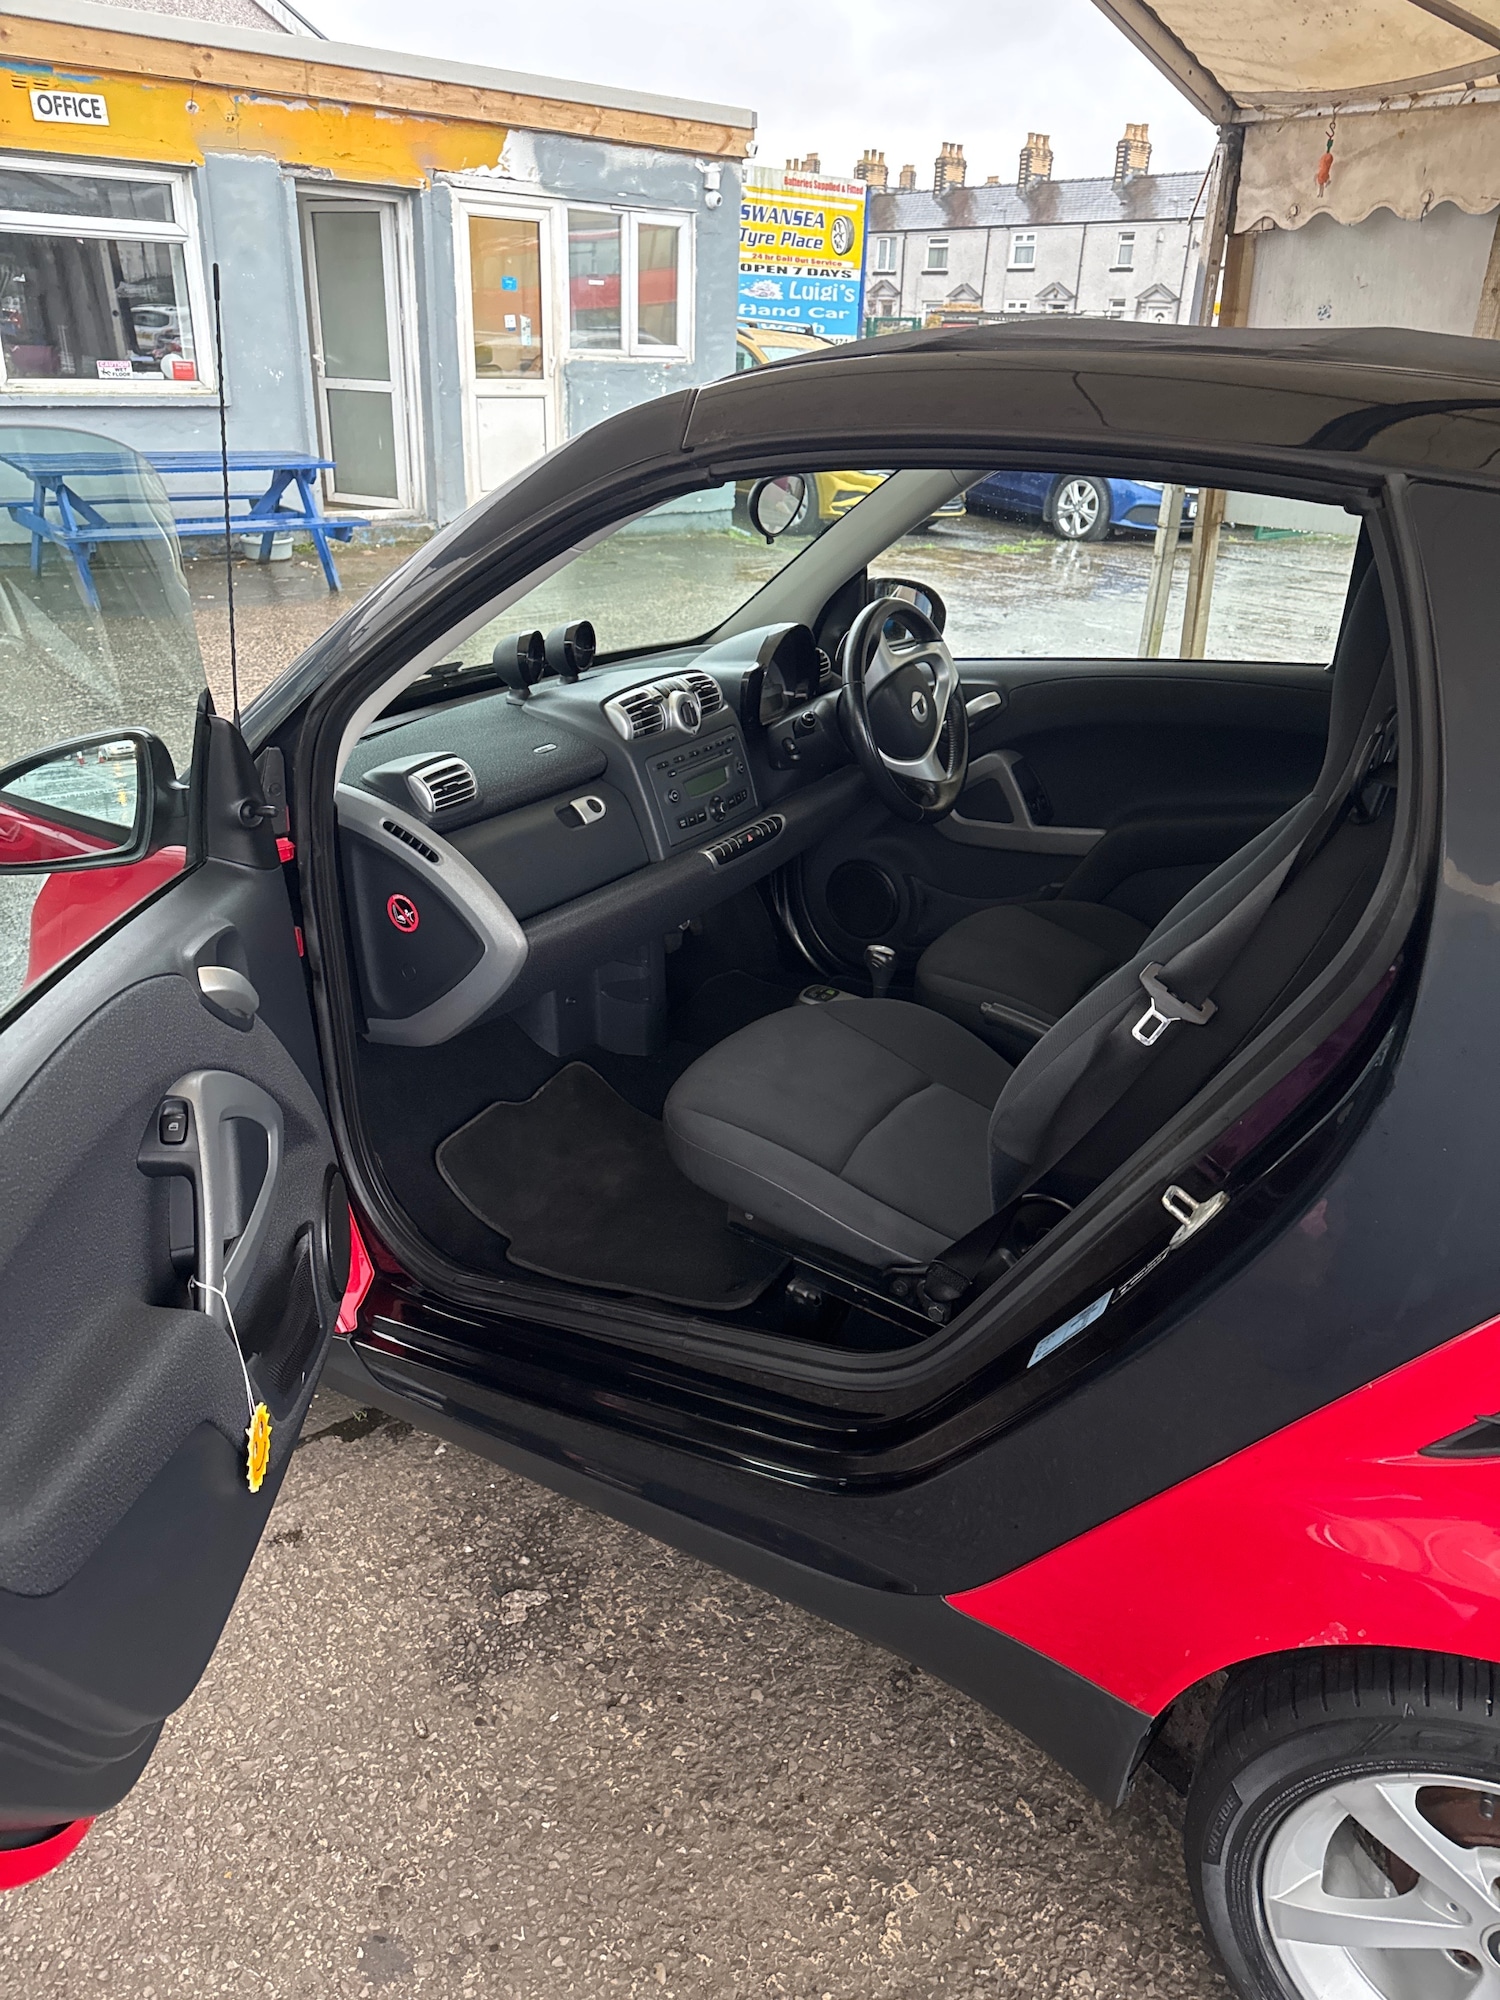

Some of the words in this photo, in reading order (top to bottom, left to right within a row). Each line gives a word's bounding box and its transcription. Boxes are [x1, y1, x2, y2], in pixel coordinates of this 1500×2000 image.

[37, 94, 102, 119] OFFICE
[784, 176, 812, 188] Batteries
[814, 180, 840, 192] Supplied
[847, 184, 863, 195] Fitted
[741, 204, 824, 228] SWANSEA
[740, 227, 775, 247] Tyre
[780, 231, 823, 249] Place
[740, 263, 788, 275] OPEN
[791, 266, 803, 275] 7
[807, 268, 852, 278] DAYS
[811, 258, 842, 267] Service
[789, 281, 855, 303] Luigi's
[738, 303, 801, 317] Hand
[808, 307, 850, 319] Car
